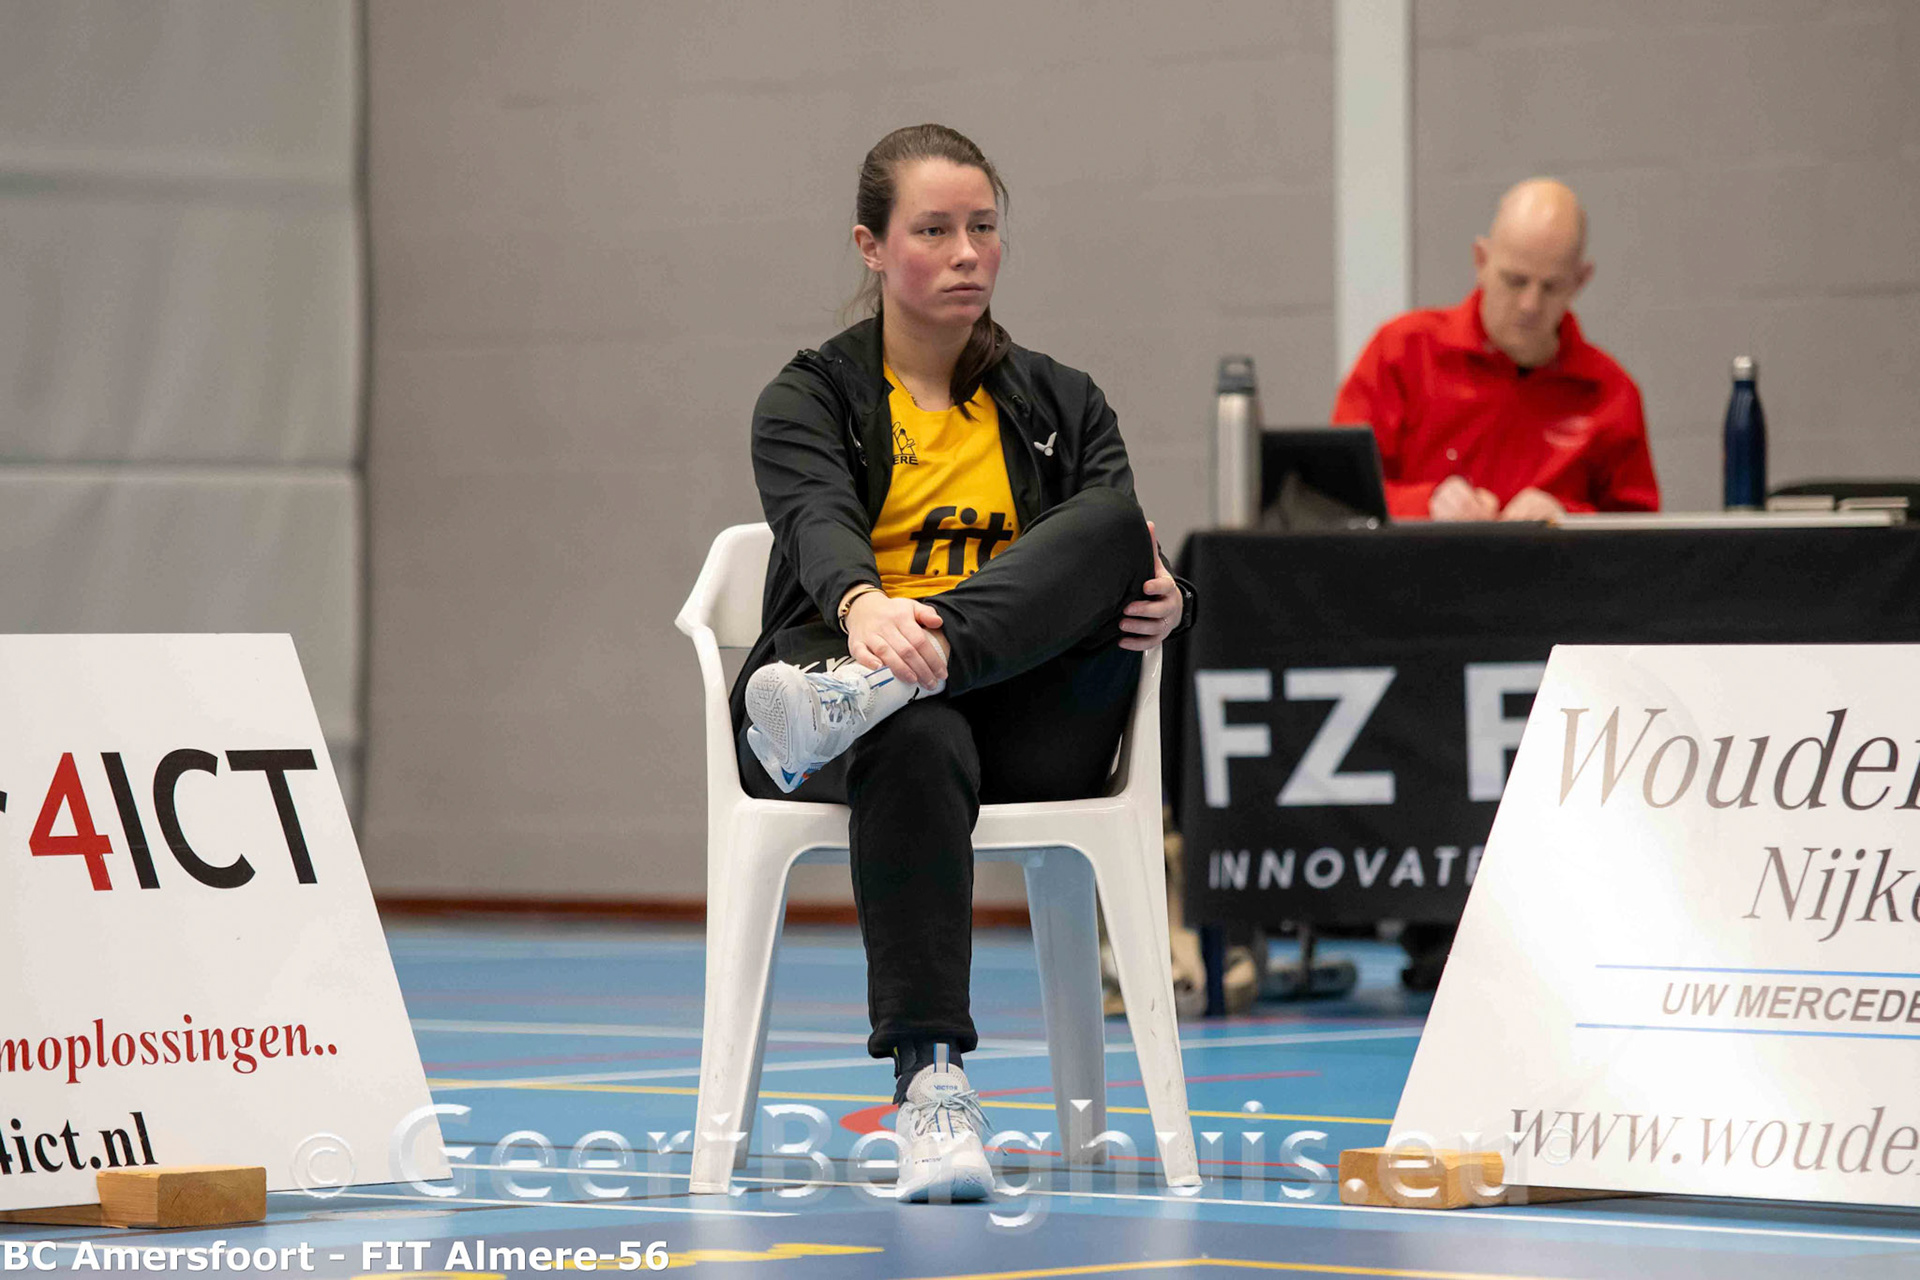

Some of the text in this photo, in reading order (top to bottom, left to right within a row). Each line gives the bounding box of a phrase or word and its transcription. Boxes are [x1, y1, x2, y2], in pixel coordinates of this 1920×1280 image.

[1194, 666, 1395, 808] FZ
[0, 748, 318, 891] 4ICT
[1741, 846, 1920, 942] Nijk
[1662, 982, 1730, 1016] UW
[1511, 1106, 1920, 1175] www.woude
